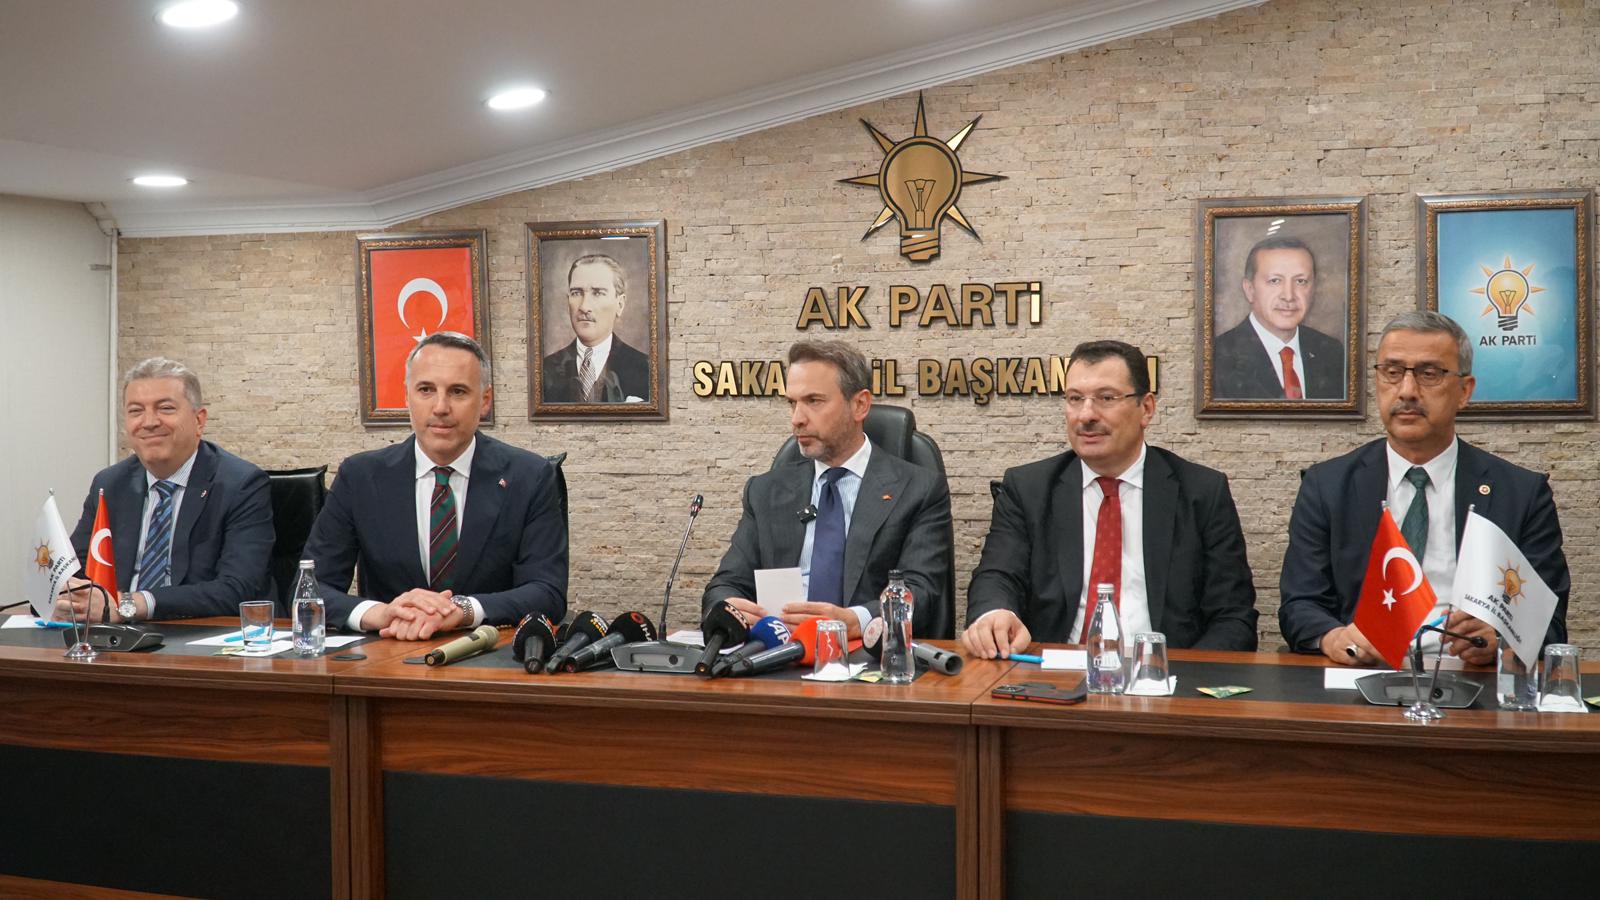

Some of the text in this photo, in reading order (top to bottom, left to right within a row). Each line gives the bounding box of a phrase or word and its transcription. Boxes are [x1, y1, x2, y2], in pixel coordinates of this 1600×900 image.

[796, 286, 871, 329] AK
[1479, 335, 1497, 346] AK
[693, 360, 787, 397] SAKA
[918, 355, 1159, 405] BAŞKANI
[1488, 594, 1499, 605] AK
